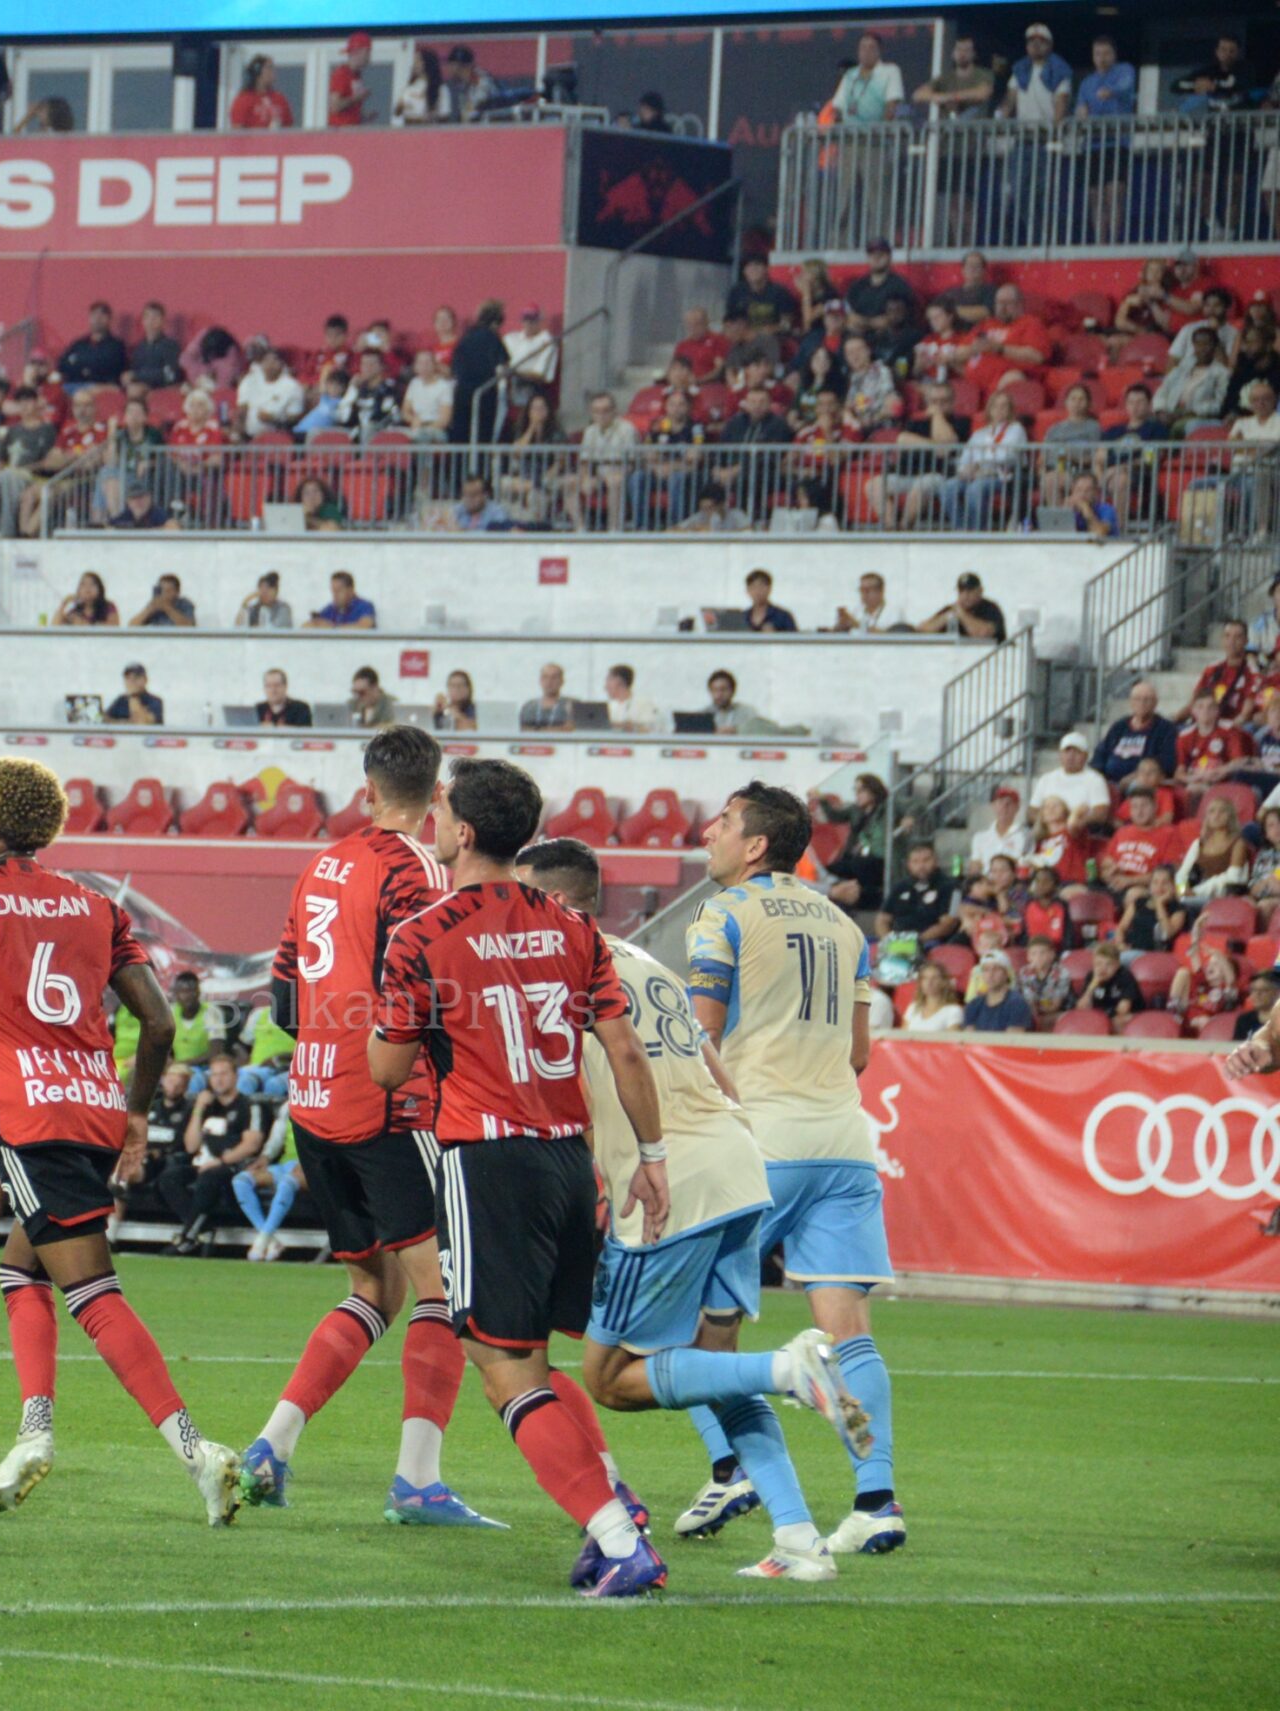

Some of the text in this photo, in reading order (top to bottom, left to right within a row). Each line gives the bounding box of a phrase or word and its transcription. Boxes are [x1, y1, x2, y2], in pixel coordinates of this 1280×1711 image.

[77, 155, 353, 227] DEEP
[313, 856, 355, 885] EILE
[297, 895, 339, 983] 3
[466, 930, 566, 960] VANZEIR
[27, 942, 82, 1026] 6
[786, 933, 838, 1025] 11
[483, 982, 576, 1083] 13
[289, 1079, 331, 1109] Bulls
